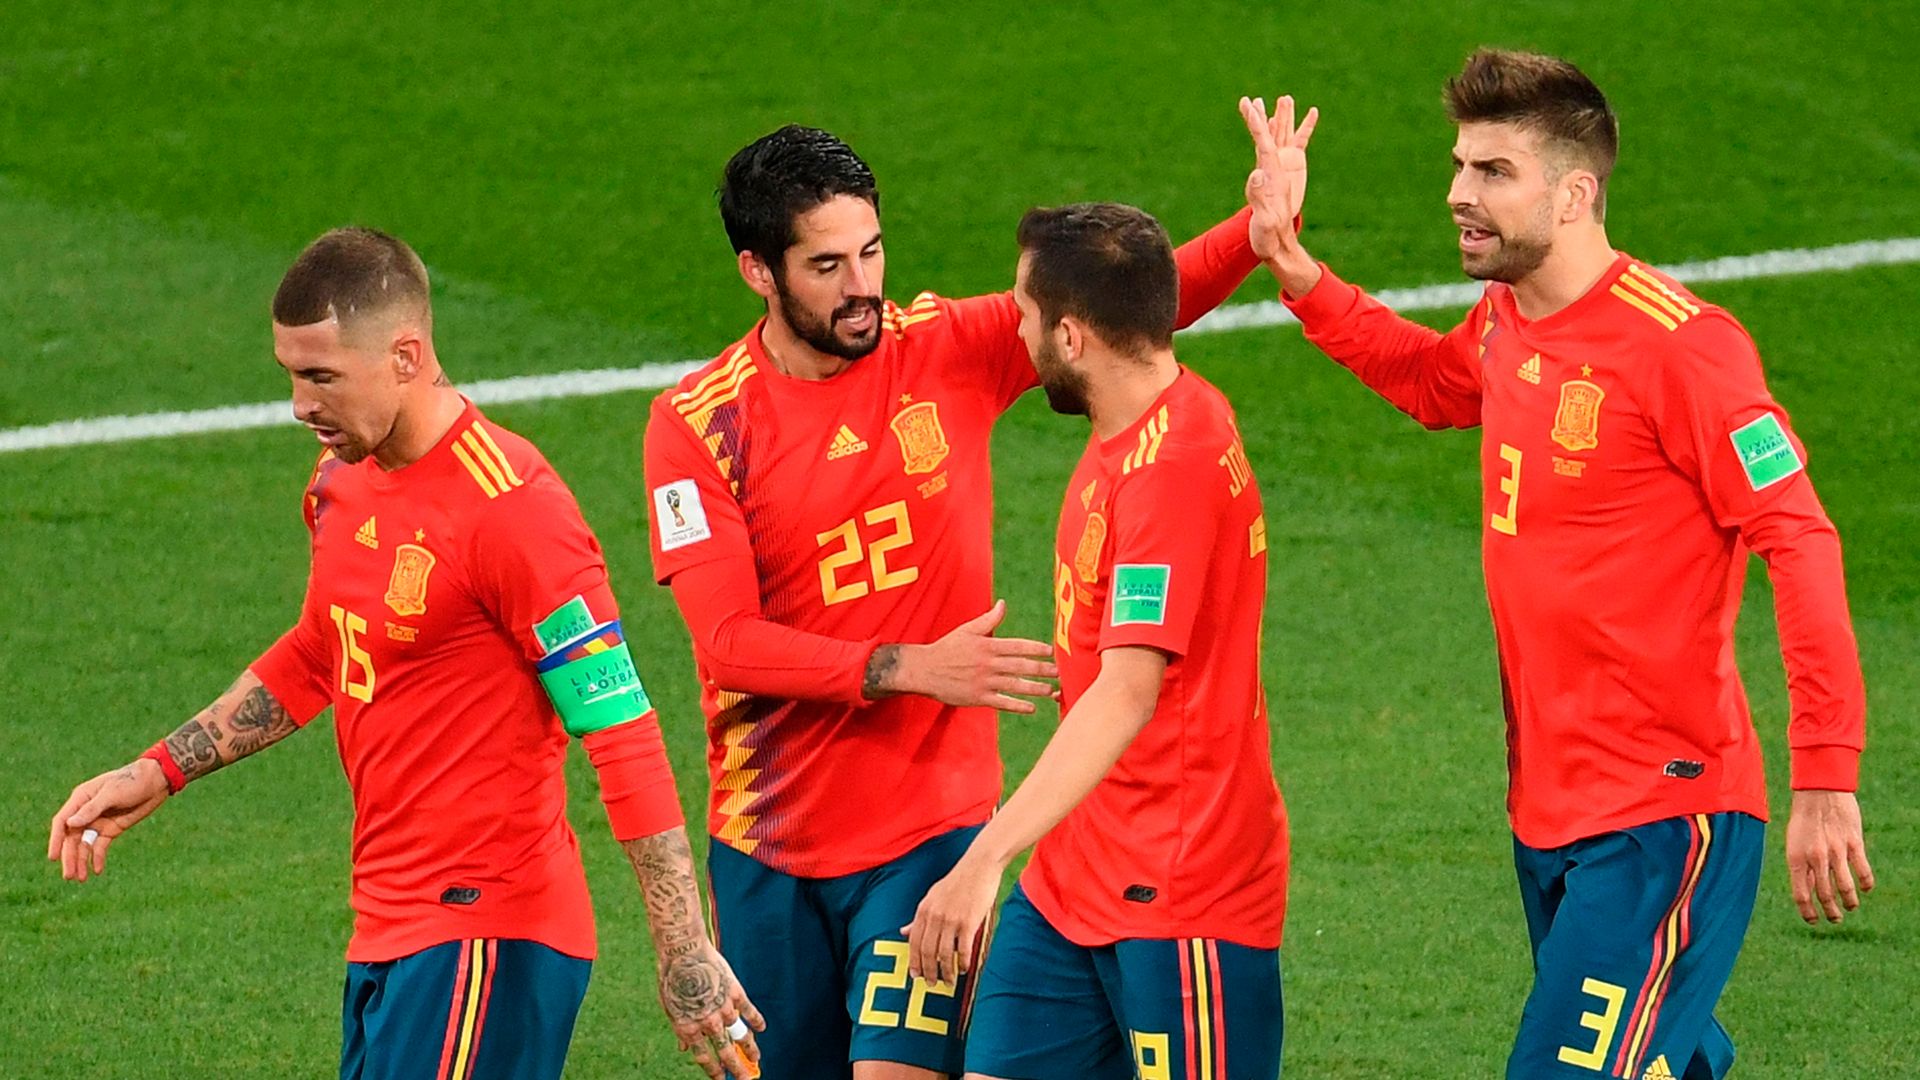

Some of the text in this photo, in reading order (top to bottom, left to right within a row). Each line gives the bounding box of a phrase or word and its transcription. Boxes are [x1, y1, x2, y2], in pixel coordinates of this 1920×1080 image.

[827, 440, 869, 461] adidas
[1490, 442, 1522, 536] 3
[815, 499, 919, 607] 22
[329, 604, 376, 704] 15
[571, 658, 630, 687] LIVIN
[575, 670, 633, 698] FOOTBA
[1557, 977, 1627, 1071] 3
